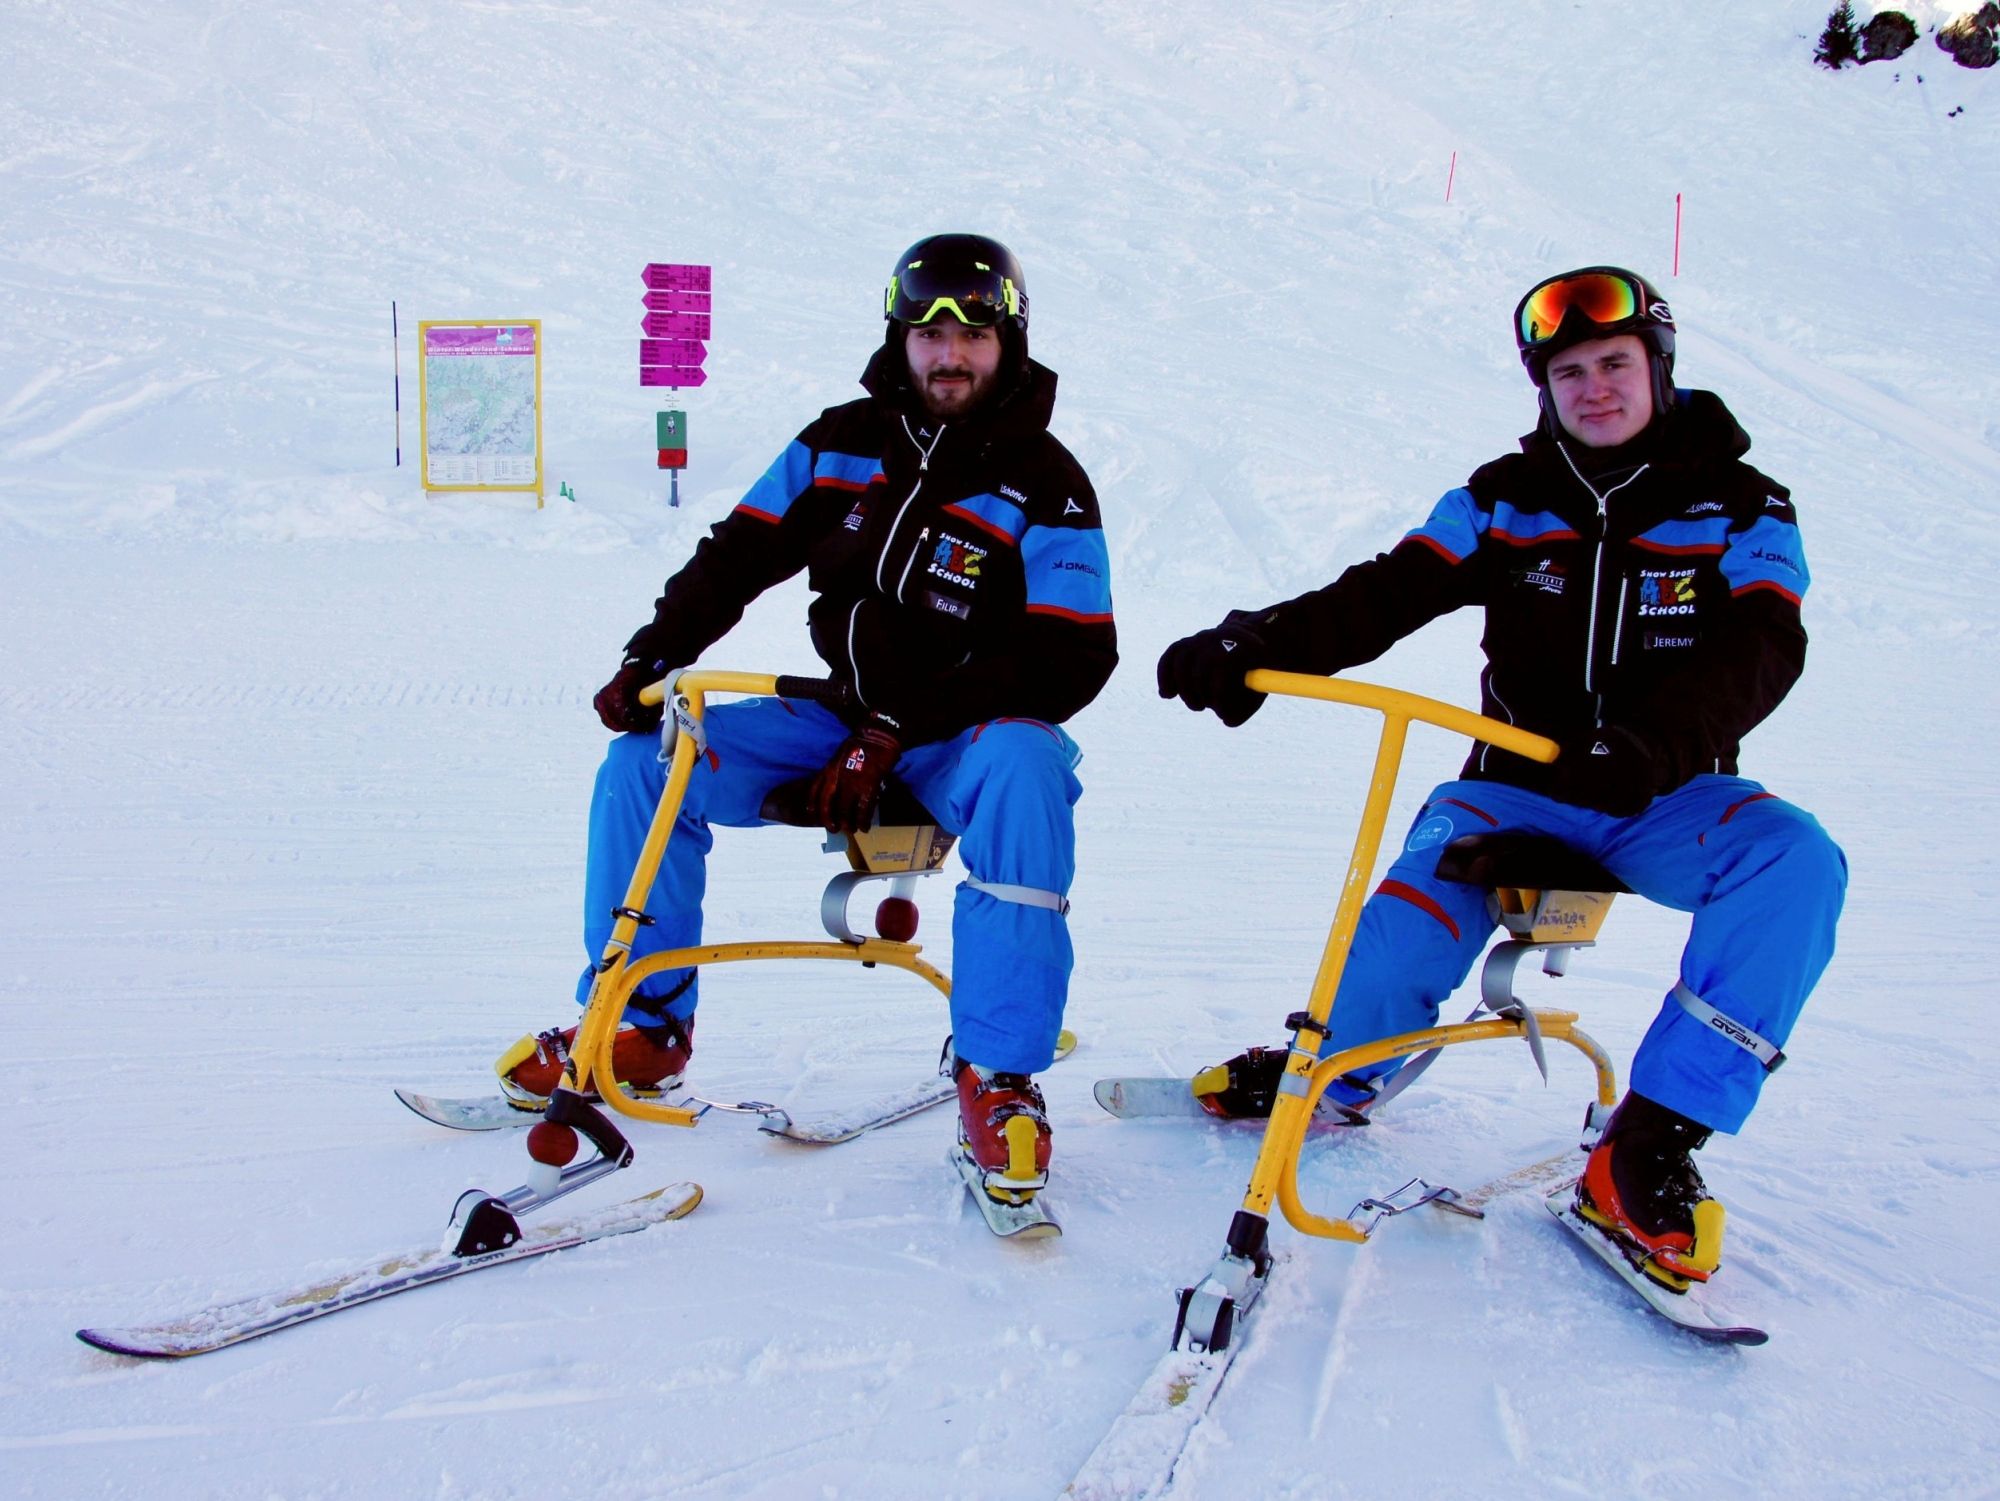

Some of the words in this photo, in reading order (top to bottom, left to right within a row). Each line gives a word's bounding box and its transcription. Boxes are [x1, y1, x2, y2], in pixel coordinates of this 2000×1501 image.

[938, 532, 963, 545] SNOW
[927, 562, 976, 590] SCHOOL
[1639, 569, 1667, 578] SNOW
[1668, 568, 1696, 578] SPORT
[935, 598, 958, 614] FILIP
[1638, 604, 1695, 616] SCHOOL
[1652, 636, 1694, 648] JEREMY
[1711, 1017, 1758, 1050] HEAD
